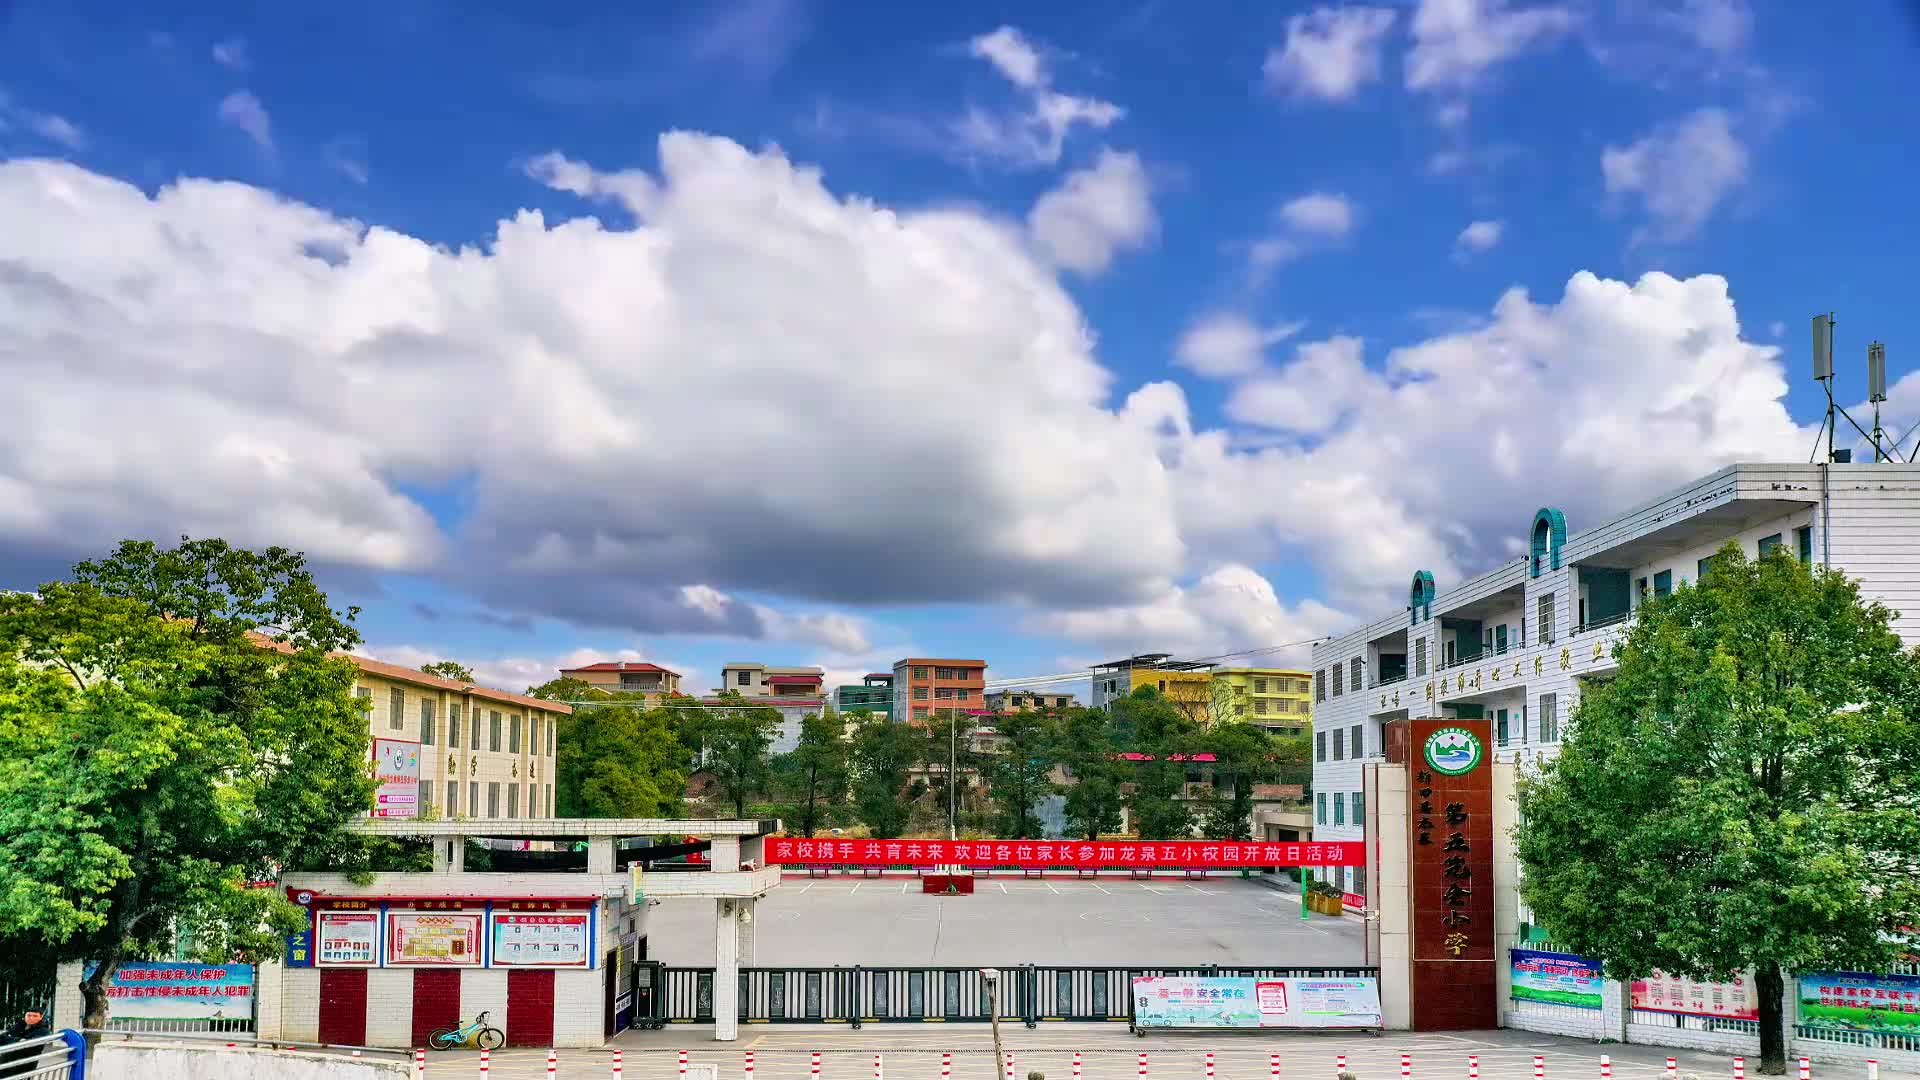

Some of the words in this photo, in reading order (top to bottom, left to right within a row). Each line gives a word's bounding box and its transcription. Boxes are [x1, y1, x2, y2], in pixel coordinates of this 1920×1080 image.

[777, 841, 855, 859] 家校携手
[865, 842, 943, 860] 共育未来
[954, 844, 1344, 862] 欢迎各位家长参加龙泉五小校园开放日活动
[333, 901, 368, 909] 学校简介
[119, 968, 226, 981] 加强未成年人保护
